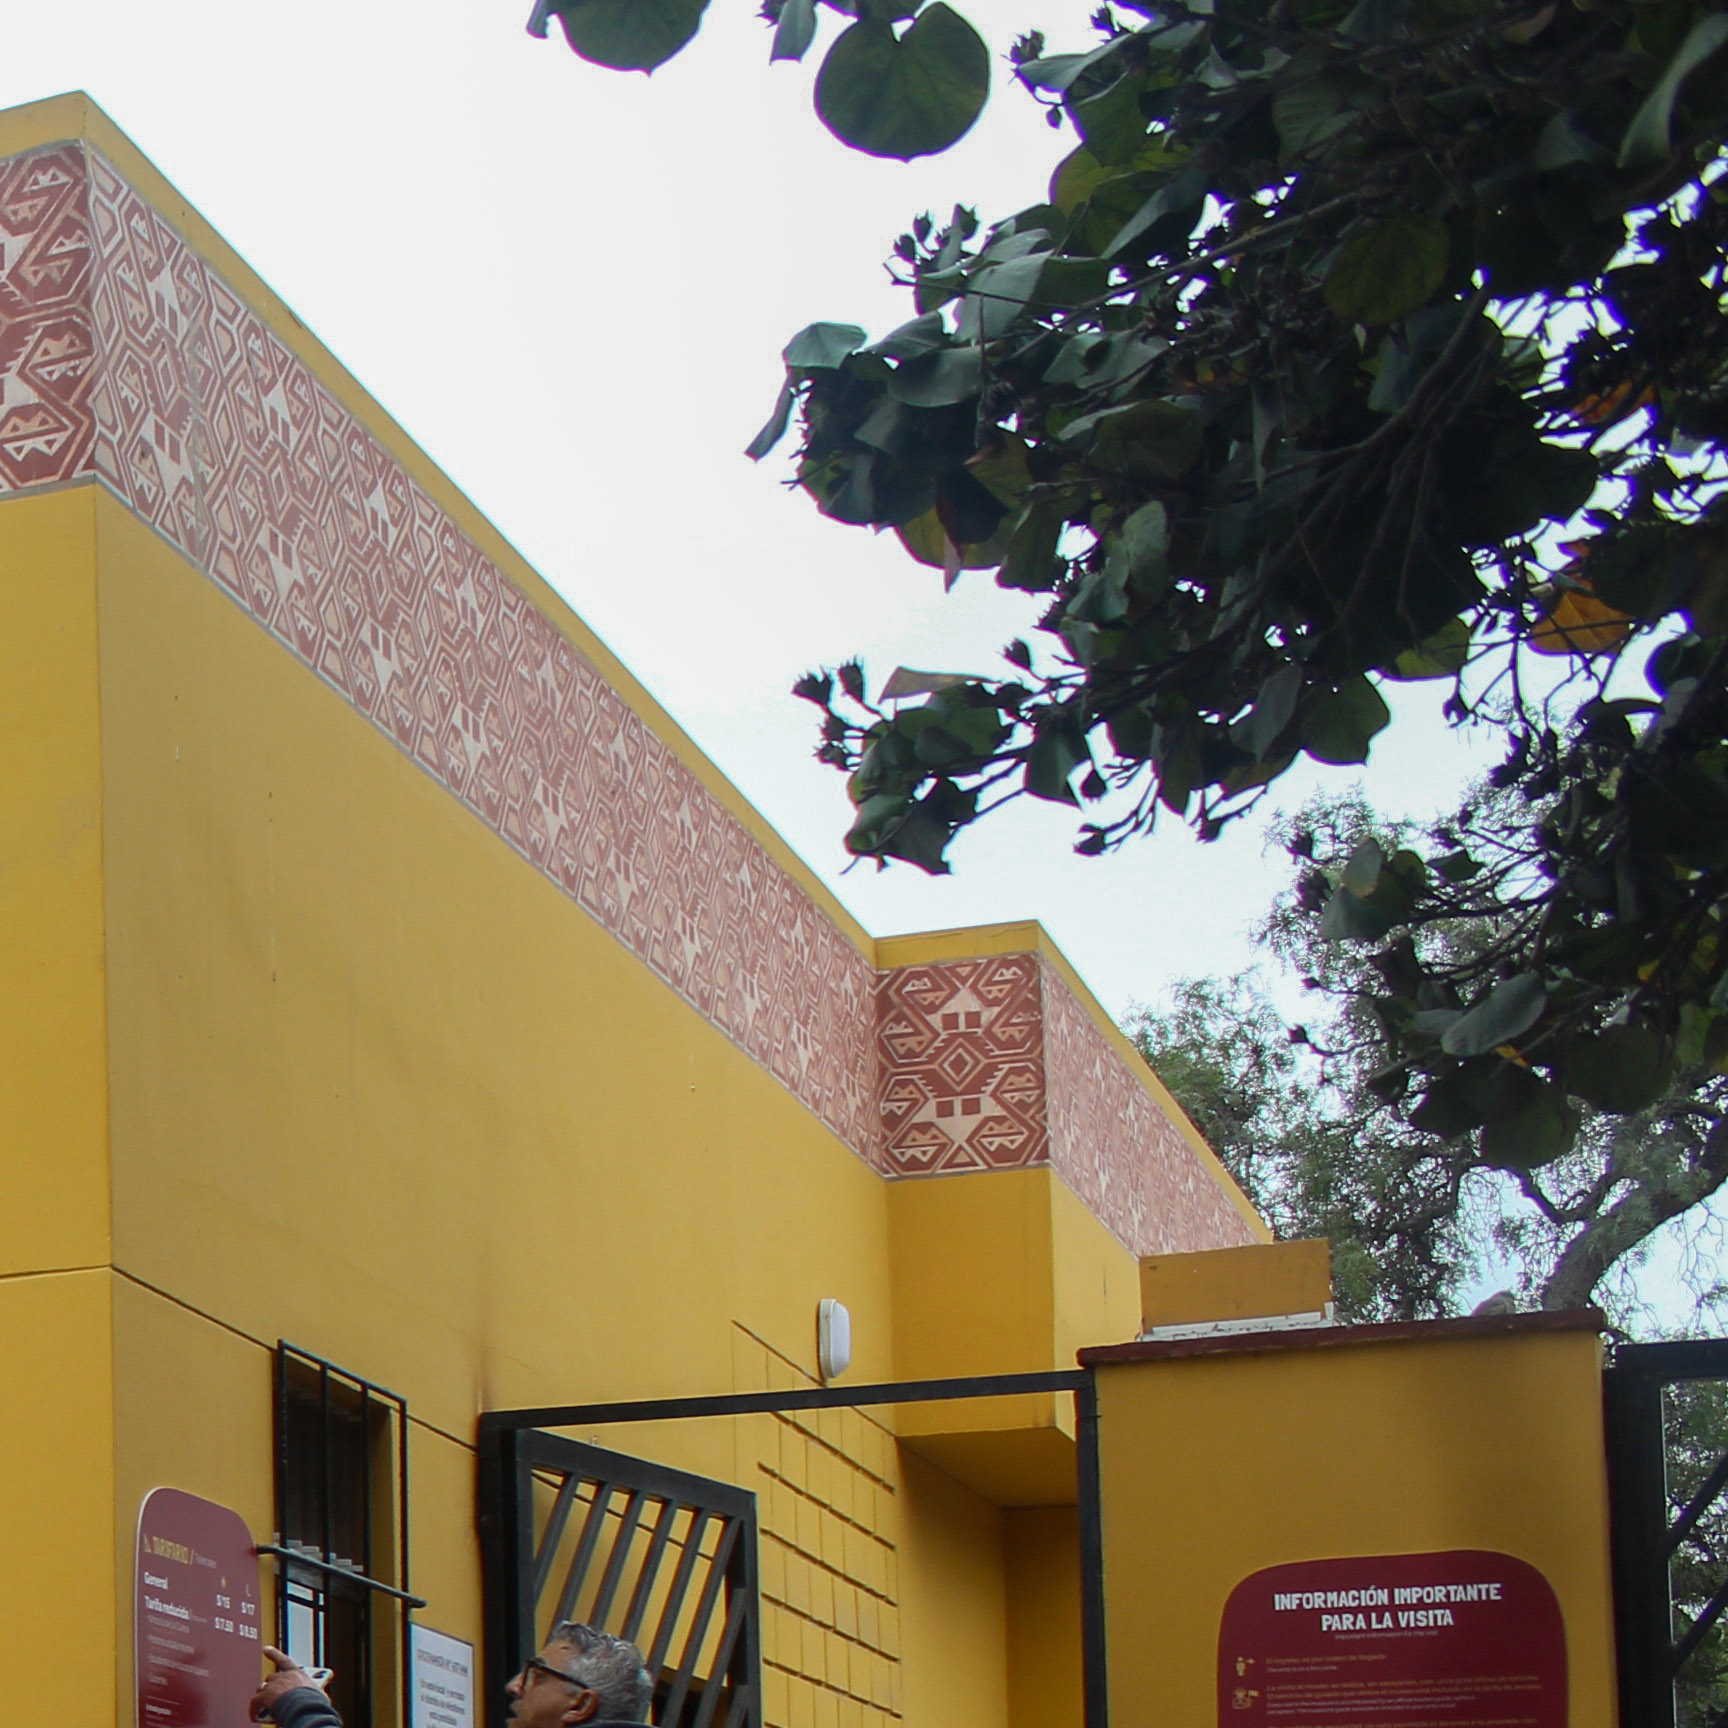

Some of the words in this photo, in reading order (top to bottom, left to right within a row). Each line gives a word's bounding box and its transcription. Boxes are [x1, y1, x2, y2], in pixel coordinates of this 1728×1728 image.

[1273, 1585, 1389, 1611] INFORMACIÓN
[1393, 1583, 1502, 1605] IMPORTANTE
[1321, 1613, 1367, 1632] PARA
[1371, 1611, 1393, 1629] LA
[1397, 1608, 1454, 1628] VISITA
